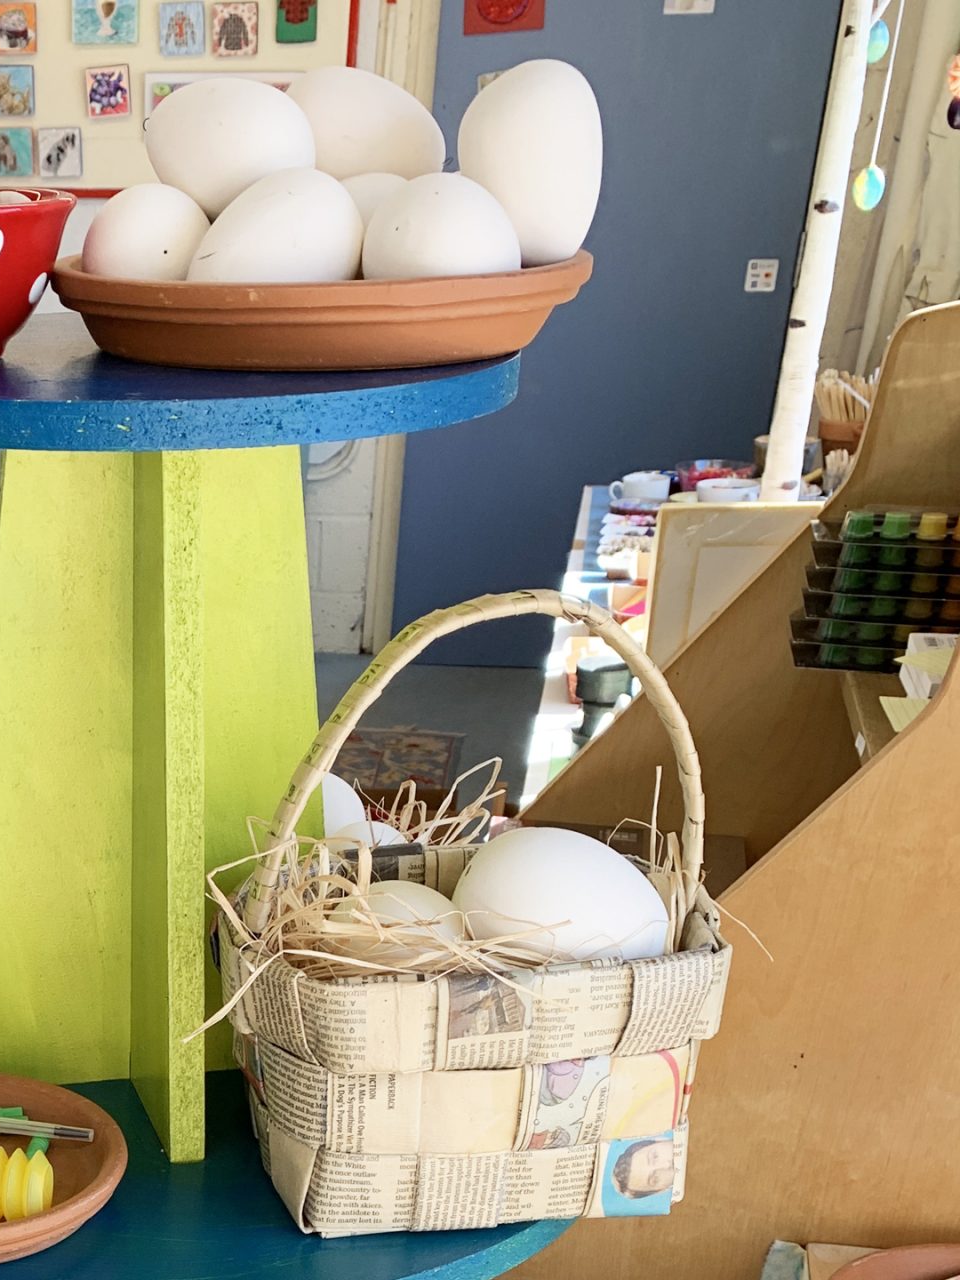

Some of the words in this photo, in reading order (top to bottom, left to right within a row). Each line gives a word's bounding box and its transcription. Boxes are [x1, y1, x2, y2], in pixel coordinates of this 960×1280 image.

[336, 1090, 345, 1108] Dog's
[358, 1089, 366, 1104] Man
[388, 1073, 396, 1110] PAPERBACK
[336, 1110, 345, 1133] Purpose
[327, 1185, 370, 1194] backcountry
